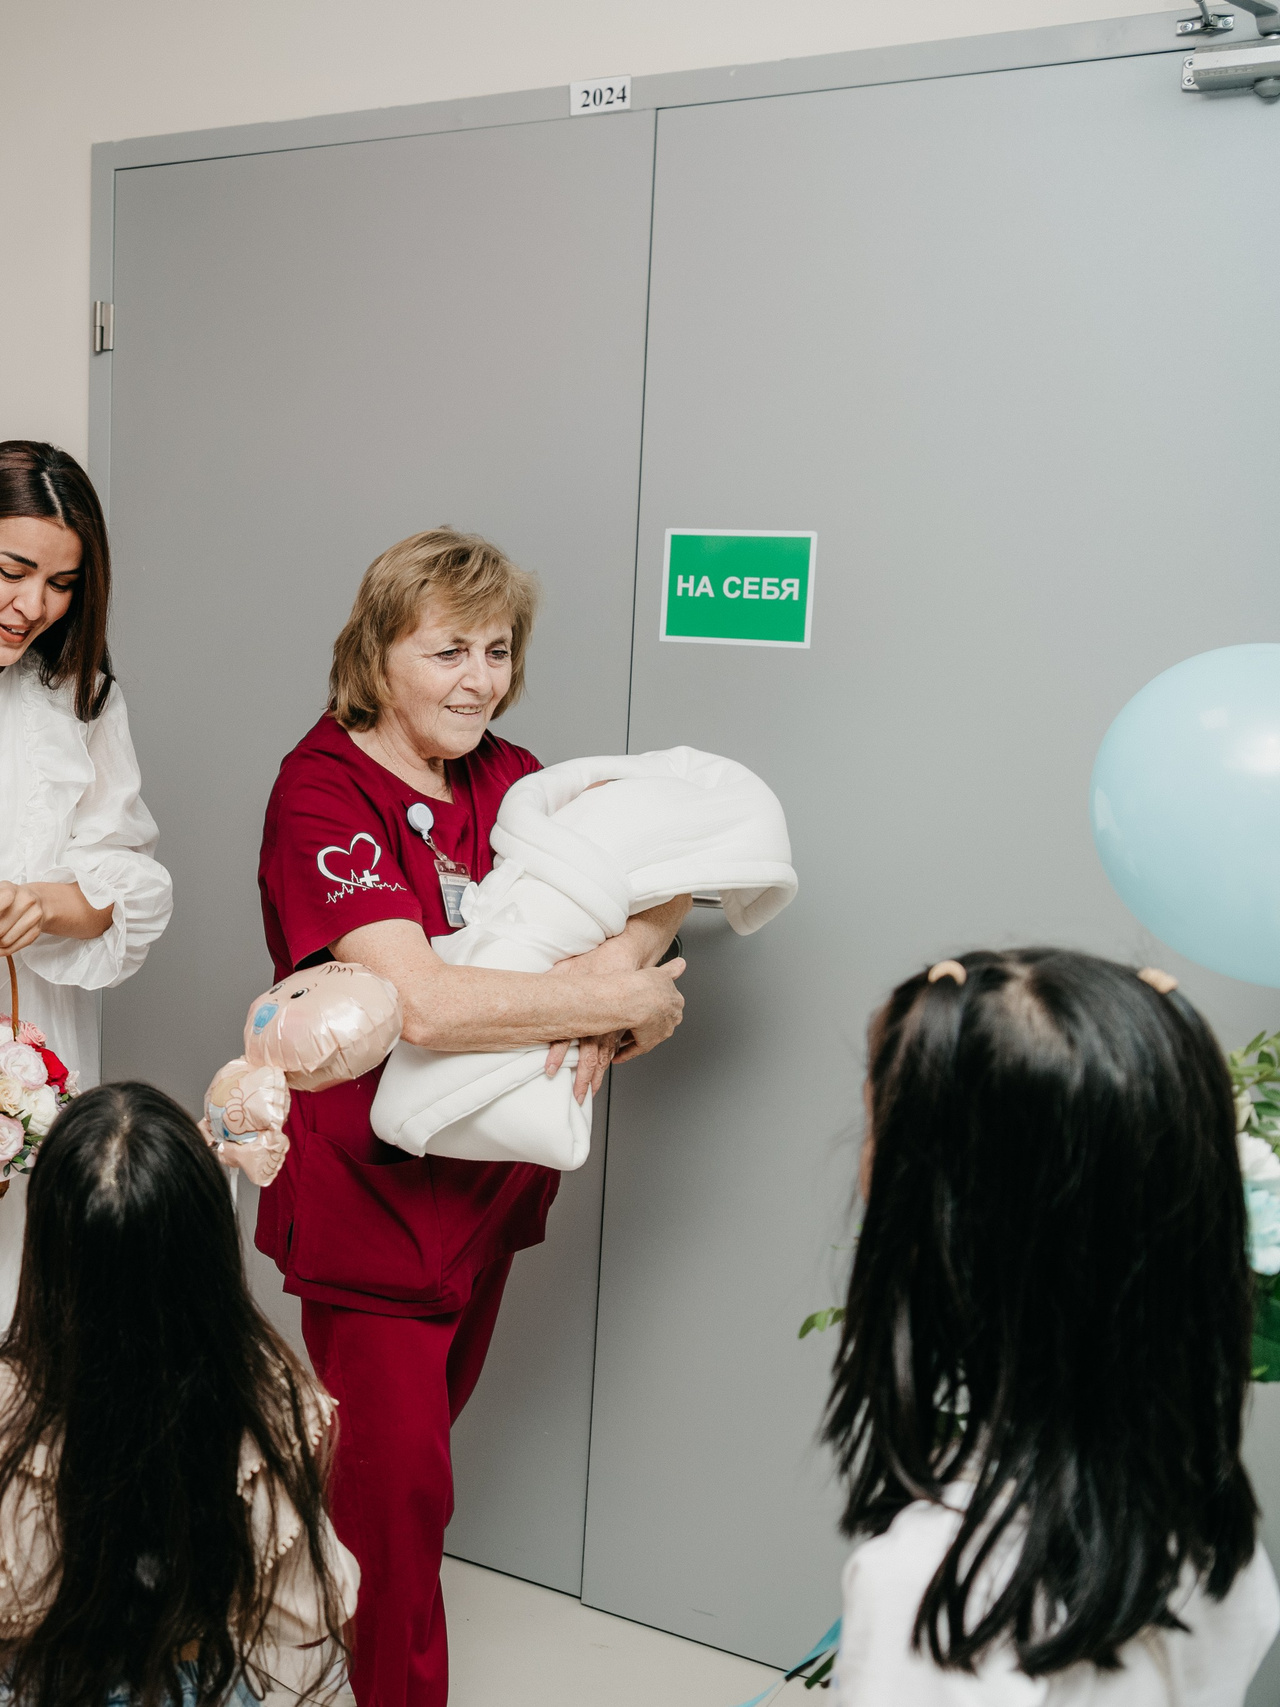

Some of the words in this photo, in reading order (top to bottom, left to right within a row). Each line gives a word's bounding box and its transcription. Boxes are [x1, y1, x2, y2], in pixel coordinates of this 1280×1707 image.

[581, 85, 627, 108] 2024
[677, 574, 715, 598] НА
[722, 576, 800, 601] СЕБЯ
